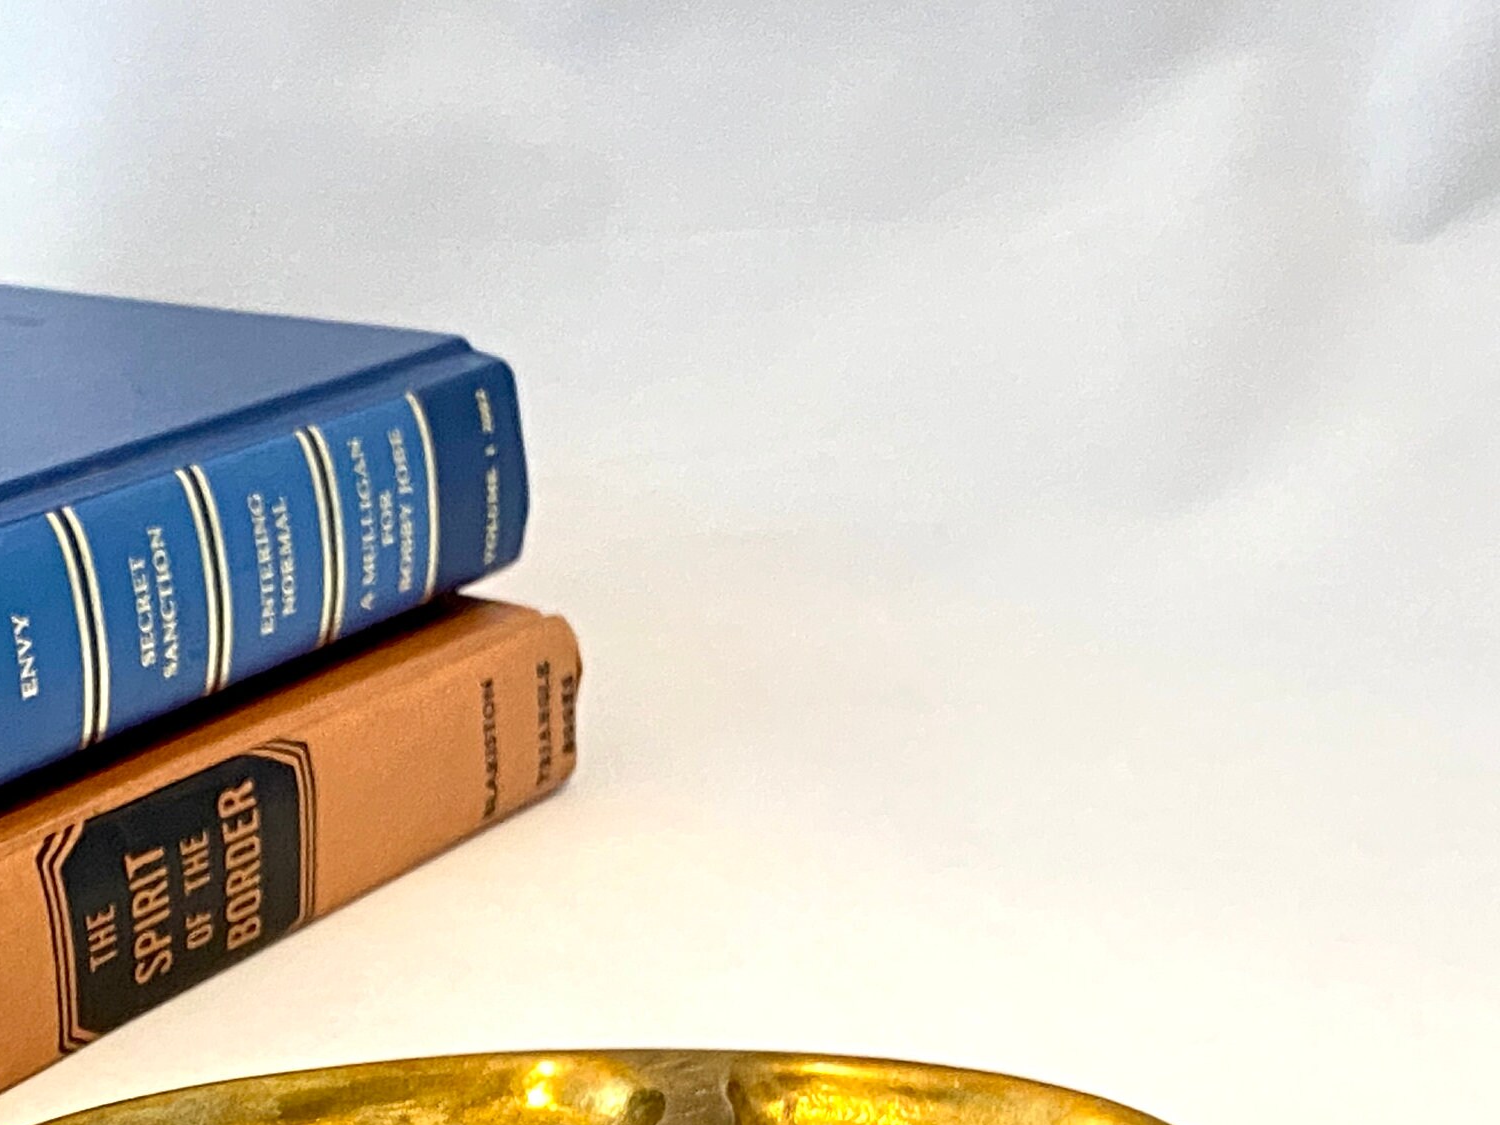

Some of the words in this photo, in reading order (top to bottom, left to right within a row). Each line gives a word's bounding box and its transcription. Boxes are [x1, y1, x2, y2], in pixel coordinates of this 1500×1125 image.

[247, 492, 277, 636] ENTERING
[272, 496, 297, 618] NORMAL
[346, 437, 376, 586] MULLIGAN
[379, 490, 395, 547] FOR
[11, 614, 39, 699] ENVY
[129, 557, 157, 668] SECRET
[147, 526, 179, 679] SANCTION
[360, 592, 375, 611] A
[124, 846, 174, 986] SPIRIT
[179, 829, 212, 896] THE
[217, 777, 263, 951] BORDER
[86, 903, 118, 973] THE
[185, 911, 214, 950] OF
